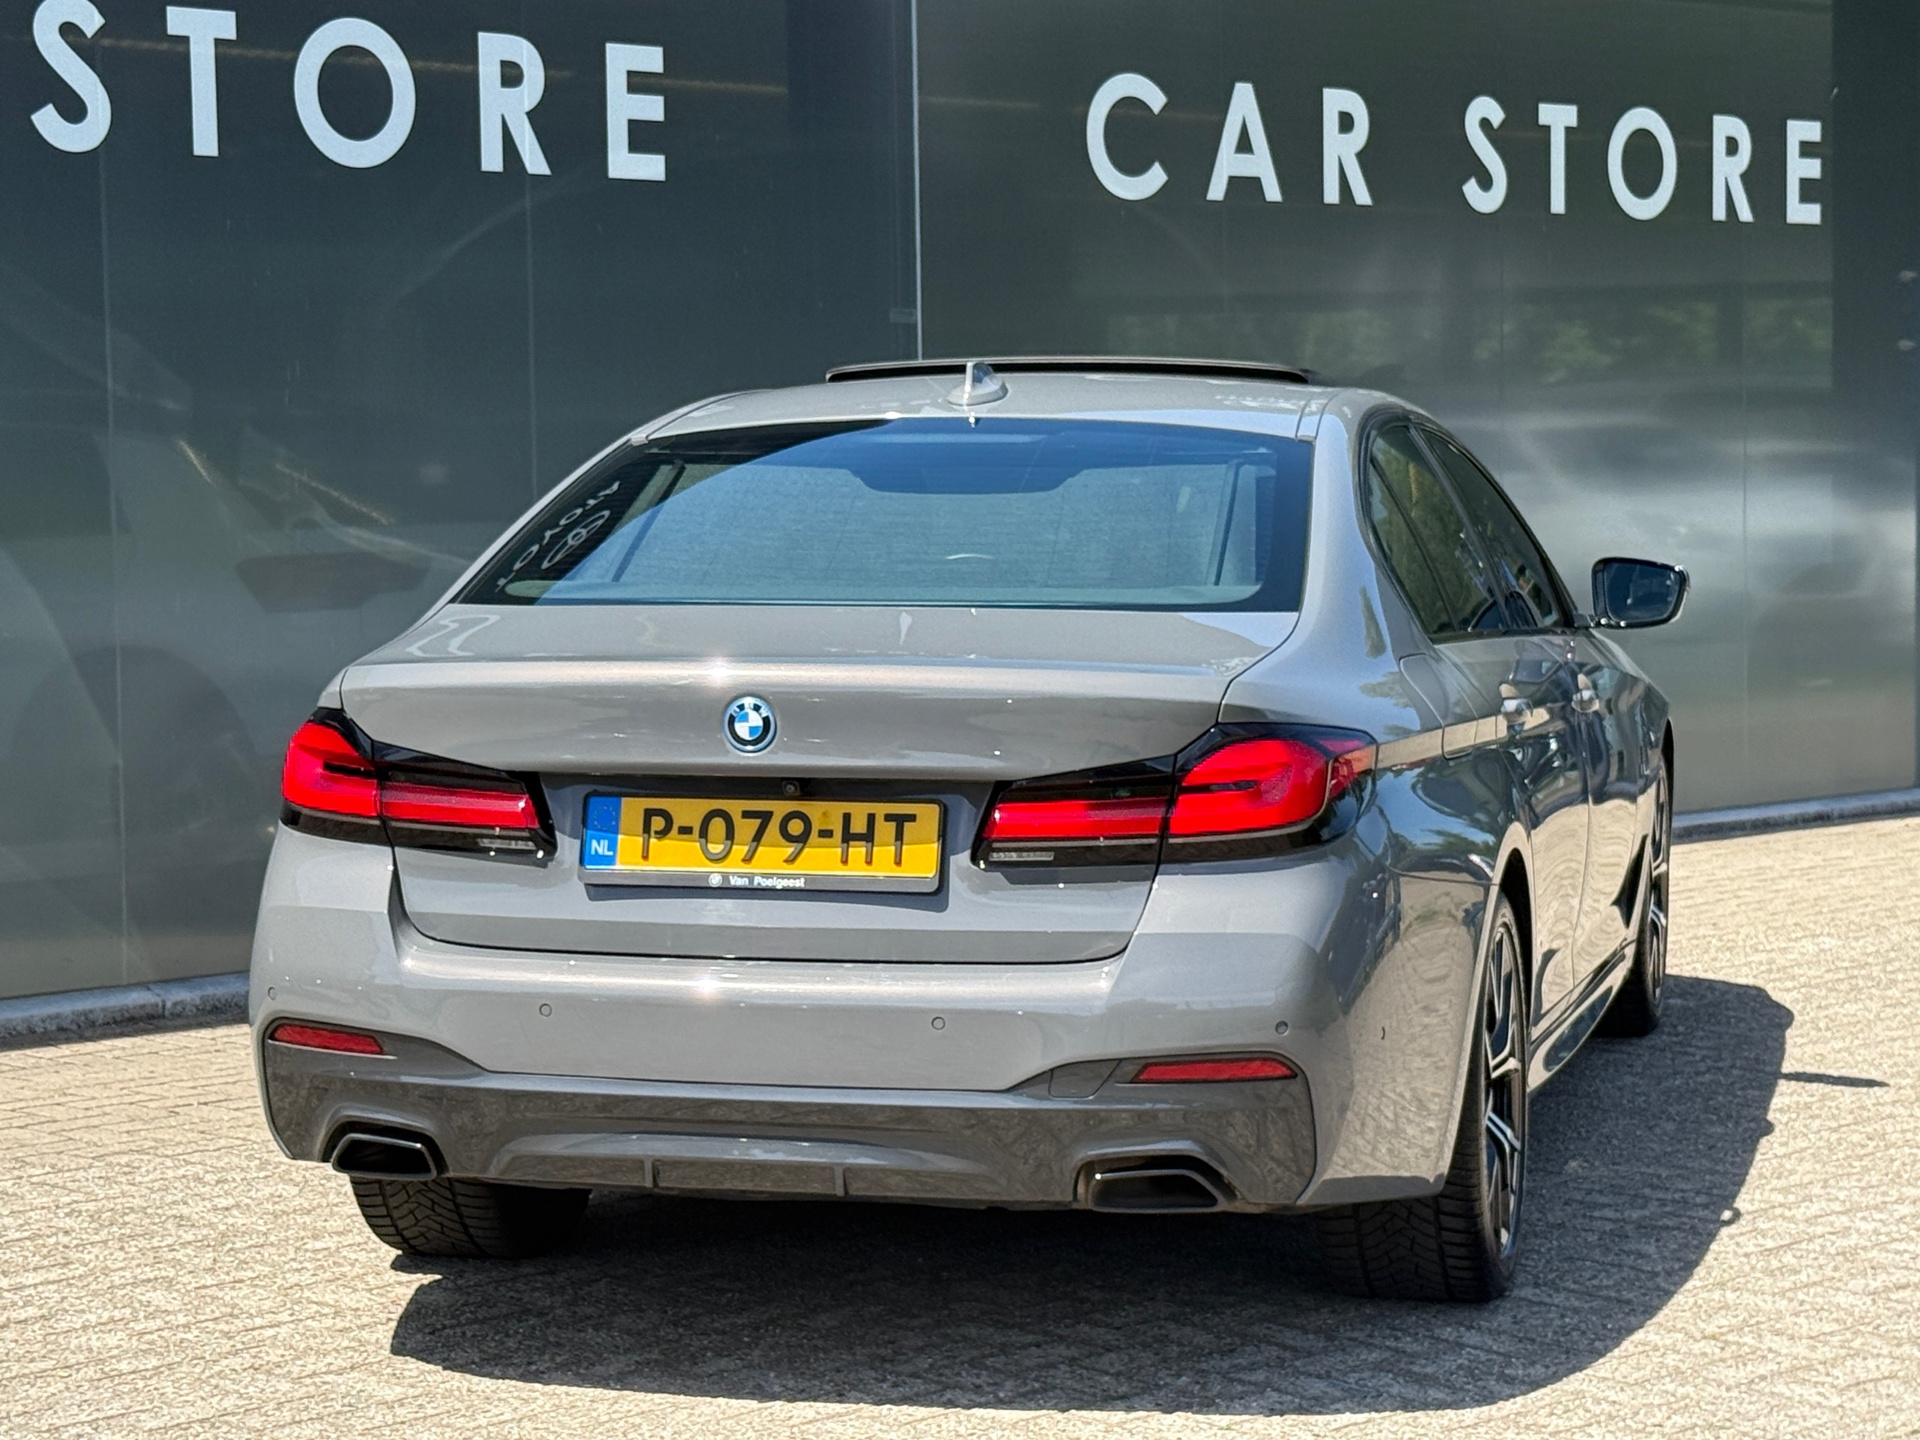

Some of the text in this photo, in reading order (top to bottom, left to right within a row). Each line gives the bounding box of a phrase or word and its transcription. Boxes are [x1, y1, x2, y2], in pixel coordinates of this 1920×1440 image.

[30, 0, 667, 182] STORE
[1086, 72, 1822, 225] CAR STORE
[590, 838, 614, 857] NL
[641, 807, 918, 867] P-079-HT
[729, 875, 806, 889] Van Poelgeest
